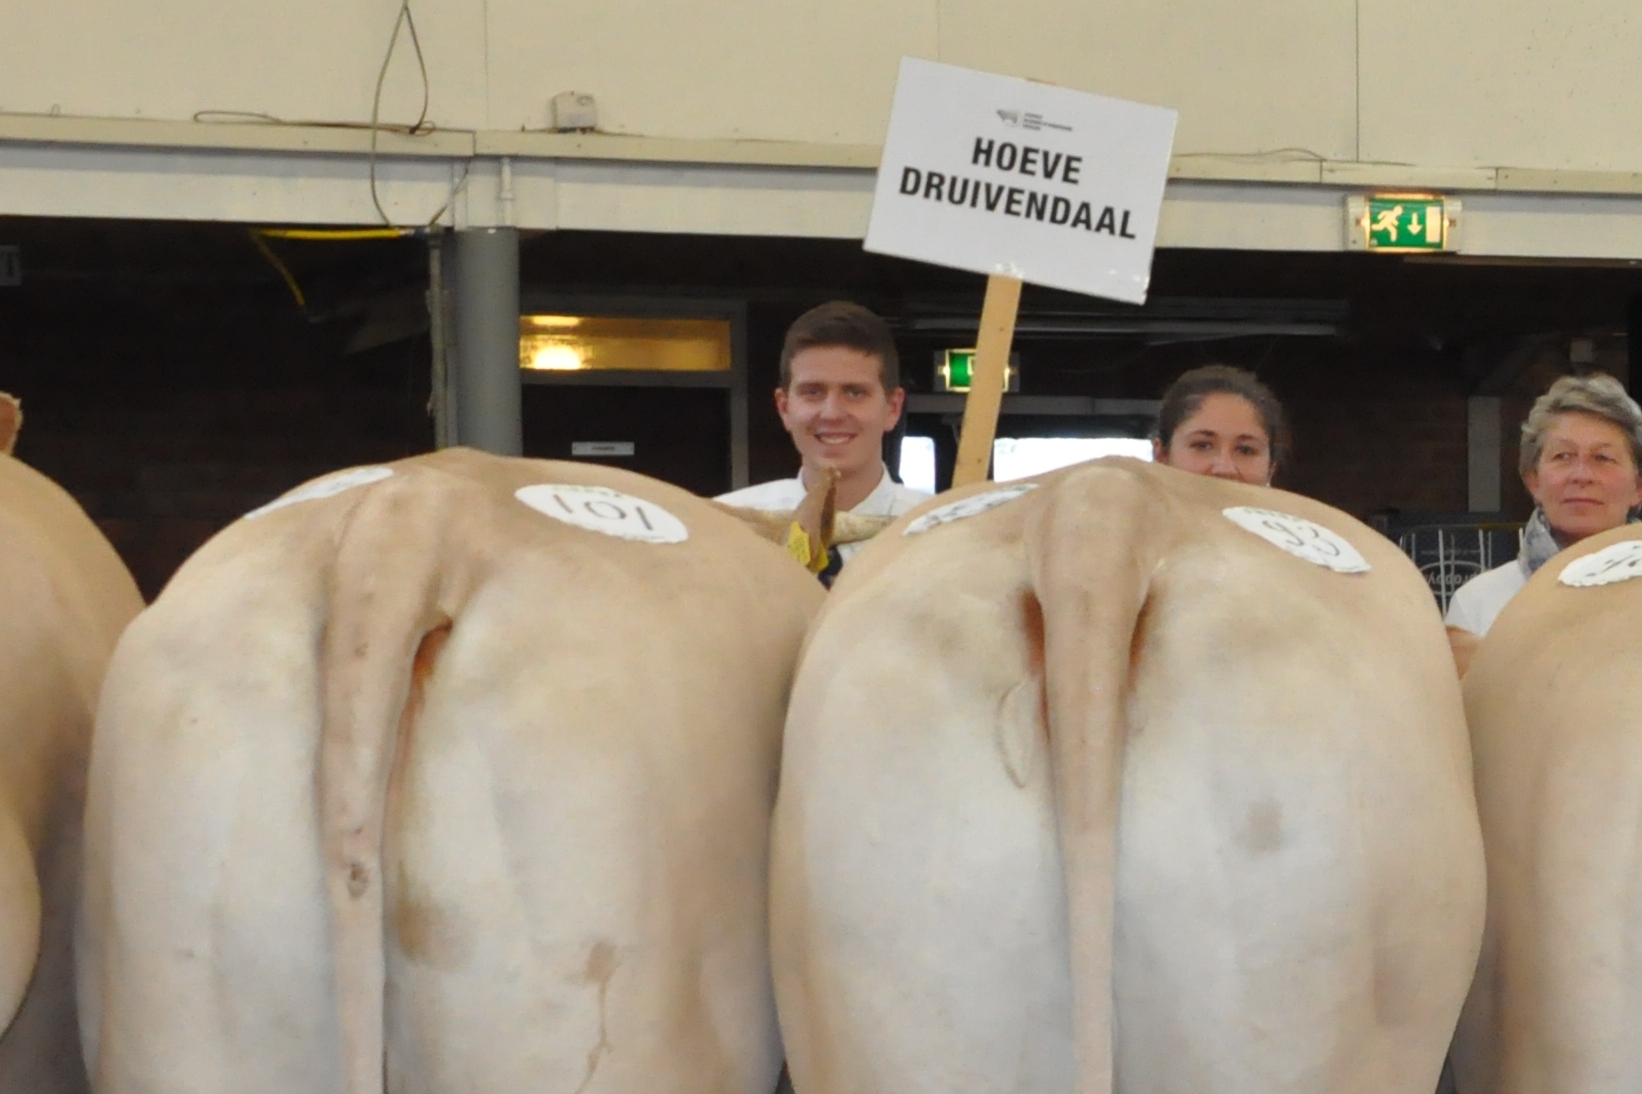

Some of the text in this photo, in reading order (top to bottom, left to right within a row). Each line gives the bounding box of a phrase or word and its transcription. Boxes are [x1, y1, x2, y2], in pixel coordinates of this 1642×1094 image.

[971, 136, 1082, 184] HOEVE
[899, 166, 1136, 239] DRUIVENDAAL
[553, 494, 653, 531] 101
